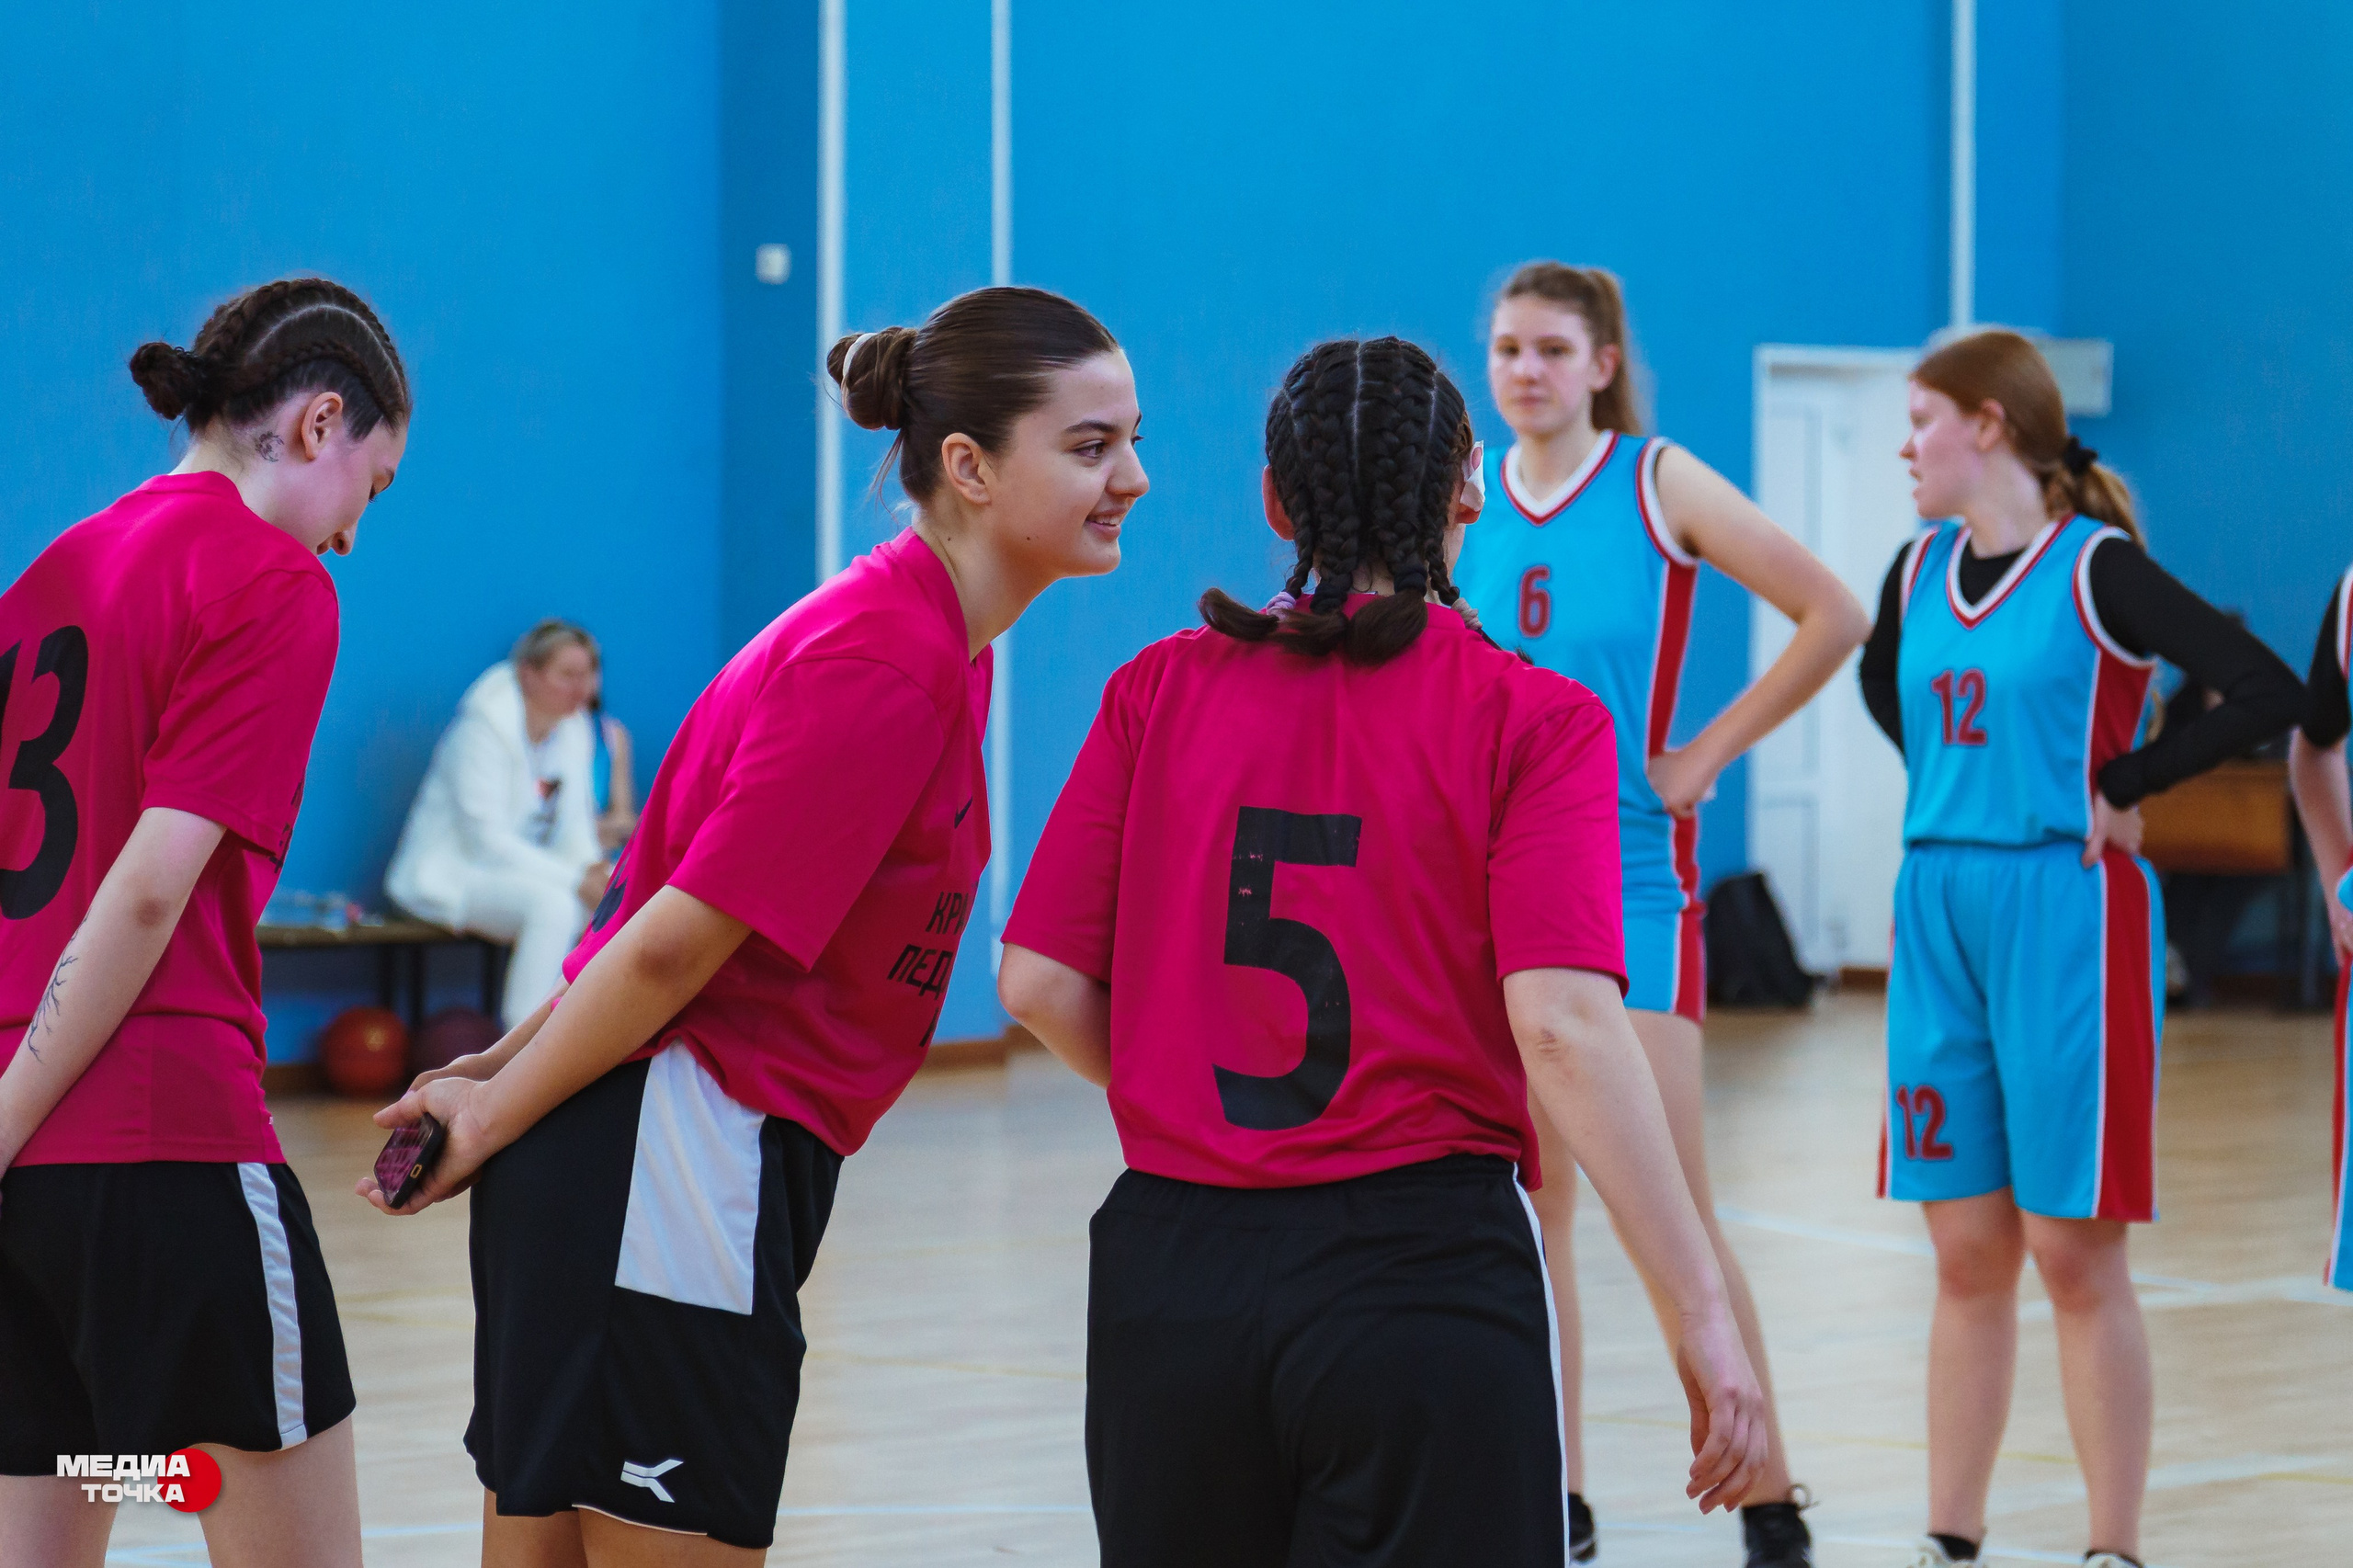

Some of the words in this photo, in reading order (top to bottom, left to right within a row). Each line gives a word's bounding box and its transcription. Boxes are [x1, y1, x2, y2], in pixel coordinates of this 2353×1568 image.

[1518, 564, 1551, 638] 6
[1931, 667, 1987, 745] 12
[1211, 806, 1362, 1131] 5
[1896, 1085, 1953, 1159] 12
